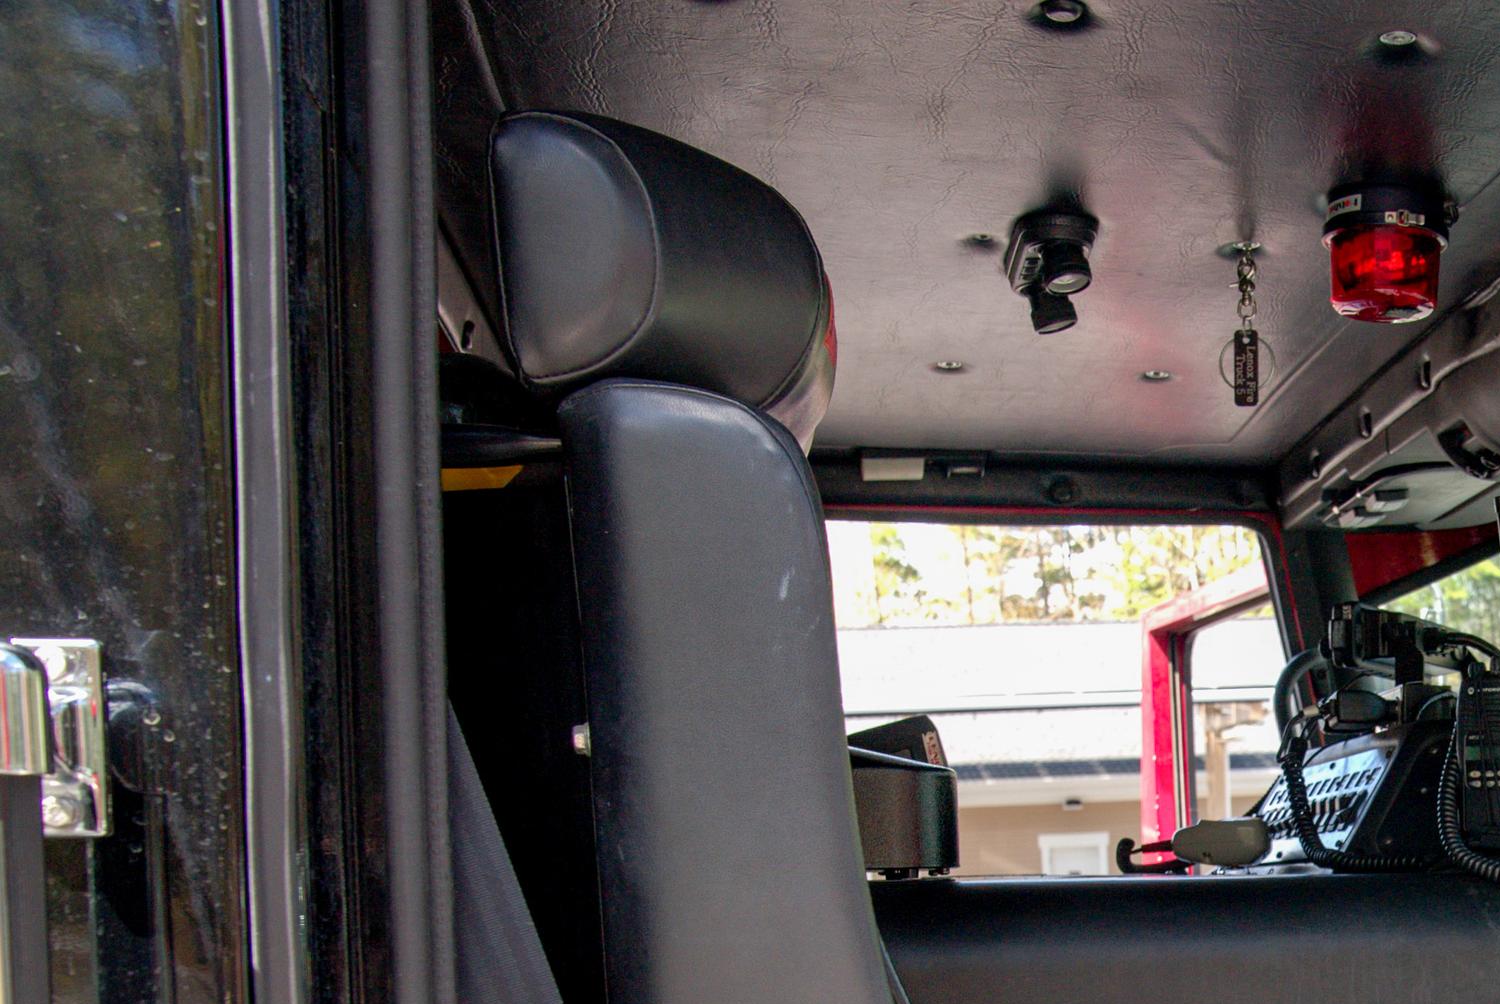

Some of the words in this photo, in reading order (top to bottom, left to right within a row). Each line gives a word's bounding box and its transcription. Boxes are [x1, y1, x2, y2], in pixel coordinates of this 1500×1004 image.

[1236, 353, 1246, 386] Truck
[1246, 345, 1256, 378] Lenox
[1246, 381, 1256, 403] Fire
